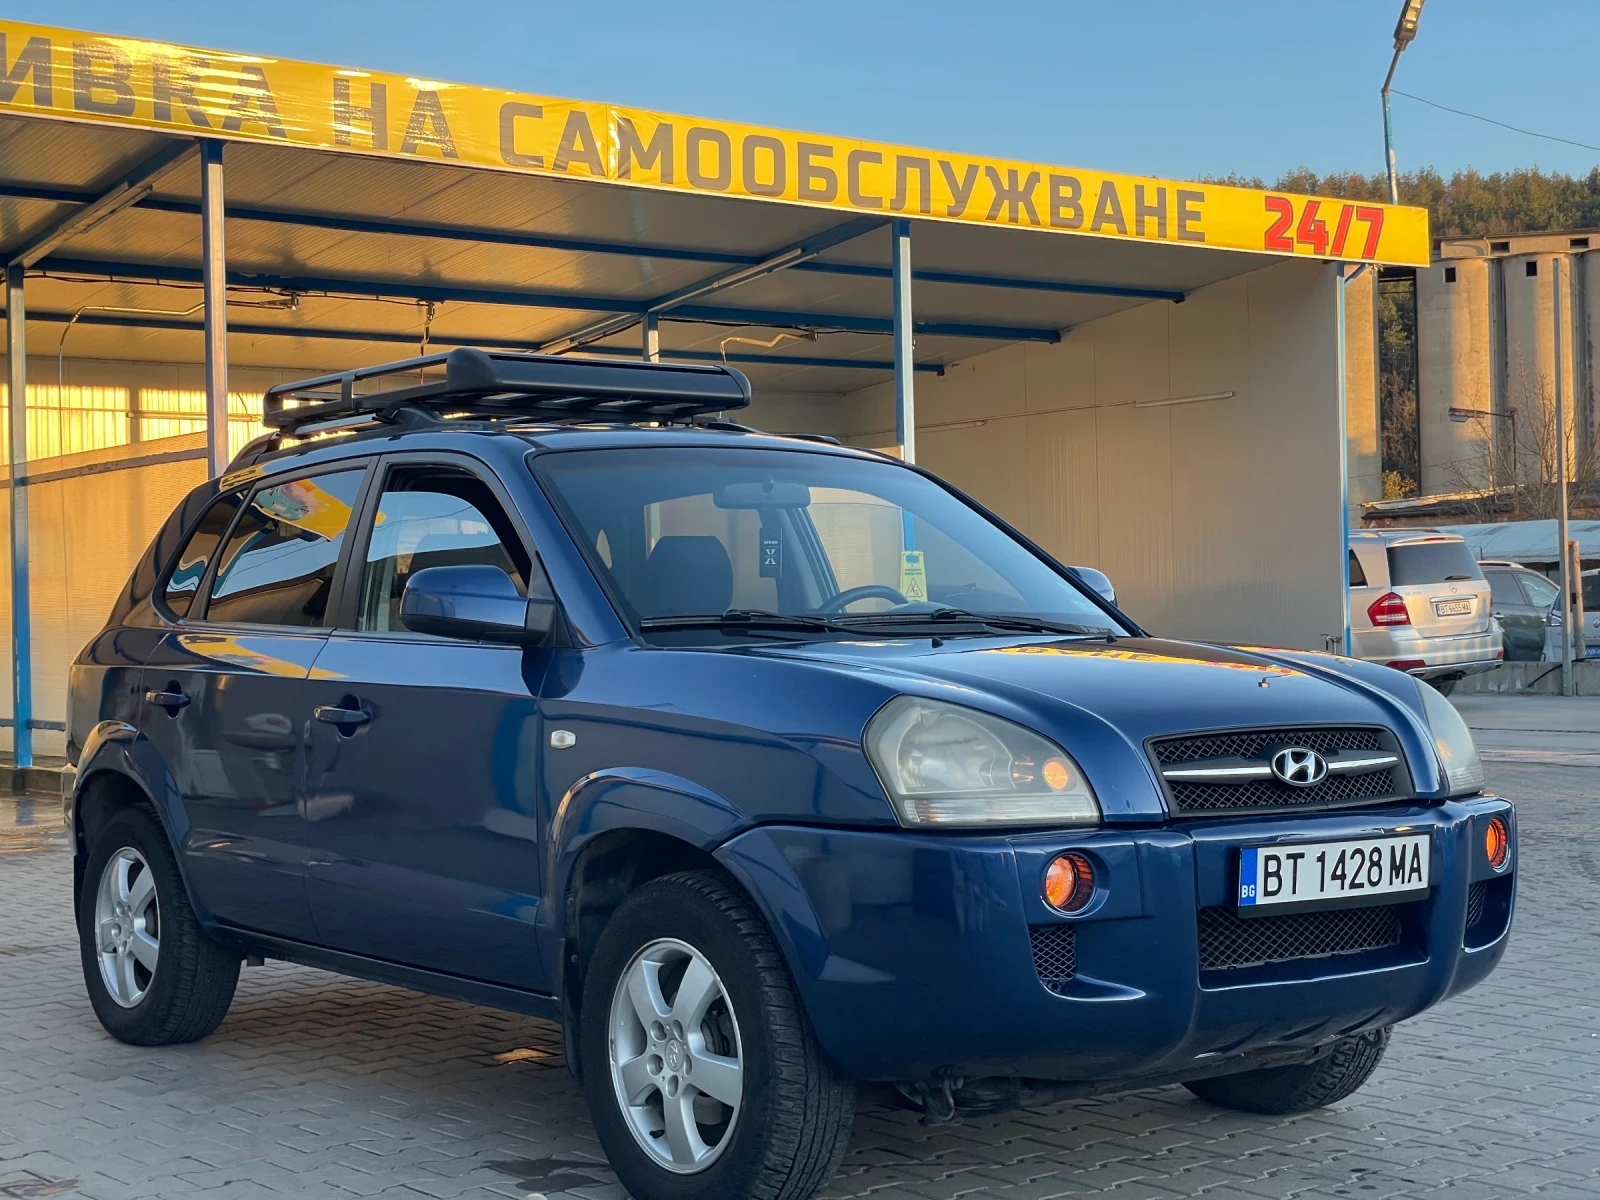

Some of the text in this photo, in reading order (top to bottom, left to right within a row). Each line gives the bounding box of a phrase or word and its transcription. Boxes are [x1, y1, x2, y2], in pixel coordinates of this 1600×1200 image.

[332, 77, 460, 159] НА
[498, 101, 1207, 242] САМООБСЛУЖВАНЕ
[1264, 195, 1384, 260] 24/7
[1241, 884, 1256, 899] BG
[1263, 842, 1423, 897] BT 1428 MA
